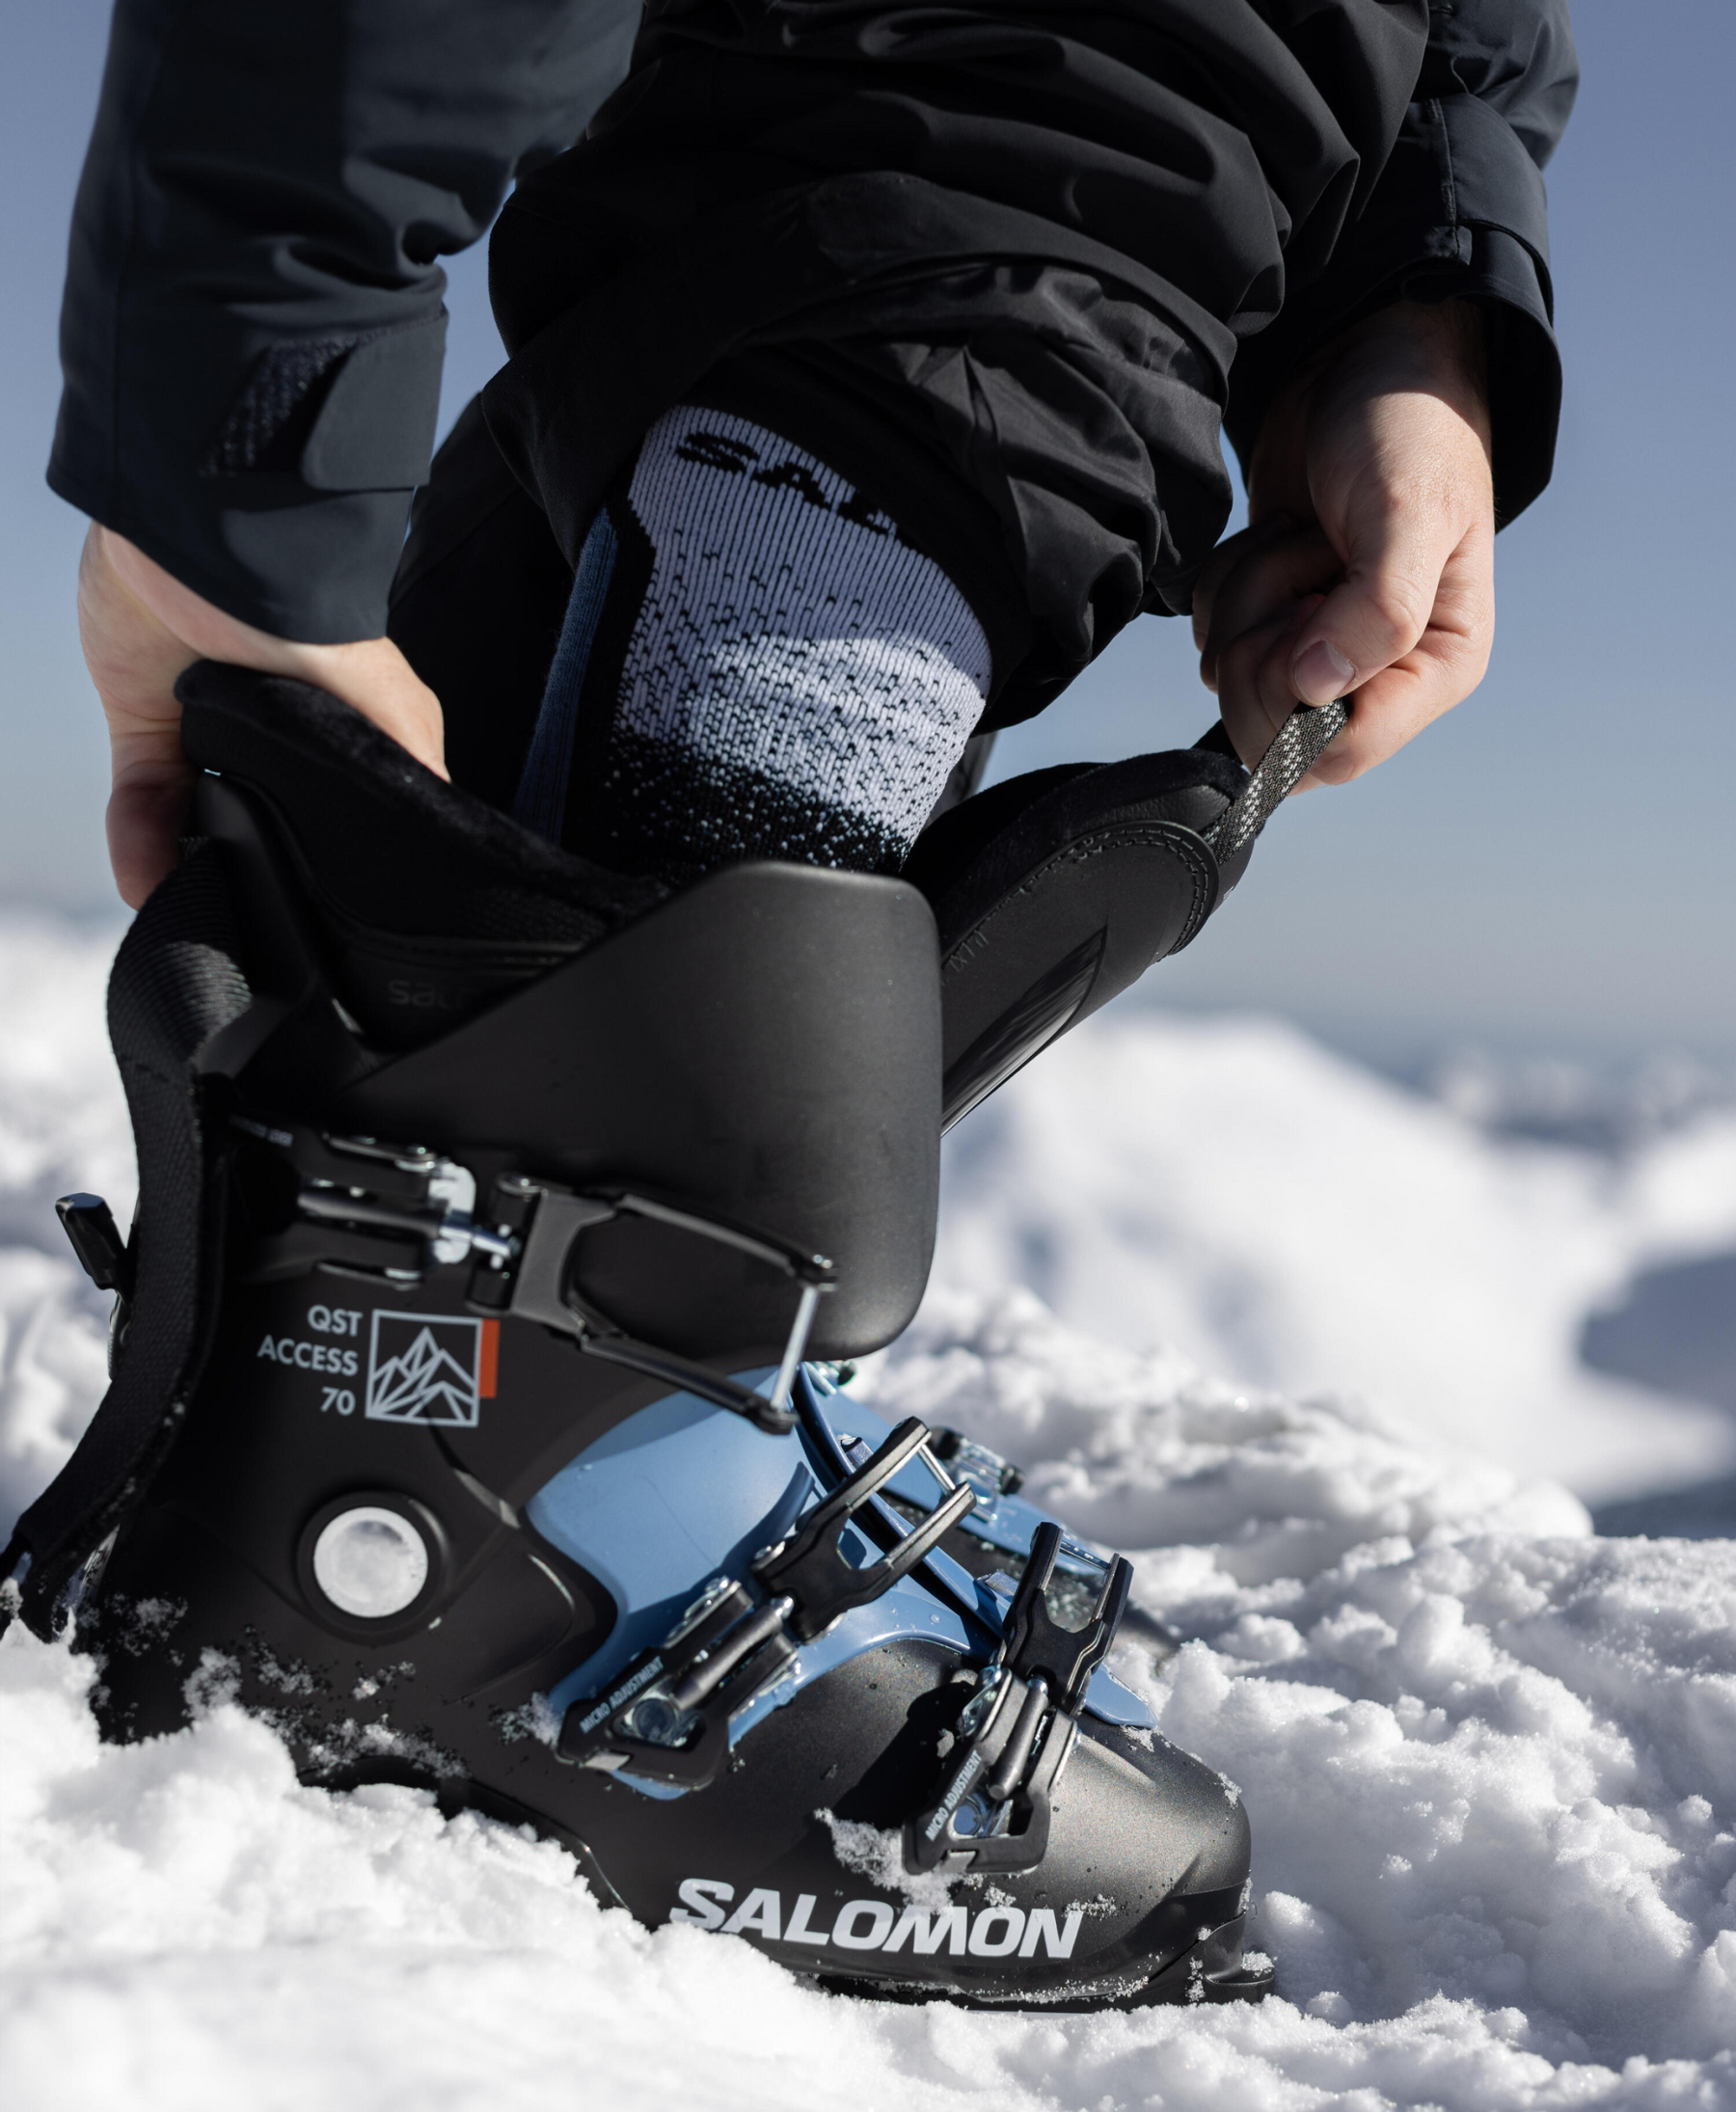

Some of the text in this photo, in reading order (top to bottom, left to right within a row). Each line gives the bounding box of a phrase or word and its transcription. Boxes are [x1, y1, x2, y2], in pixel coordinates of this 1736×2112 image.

[307, 1305, 363, 1337] QST
[257, 1335, 359, 1376] ACCESS
[320, 1386, 355, 1416] 70
[580, 1655, 665, 1734] MICRO ADJUSTMENT
[925, 1748, 983, 1842] MICRO ADJUSTMENT
[669, 1878, 1084, 1960] SALOMON
